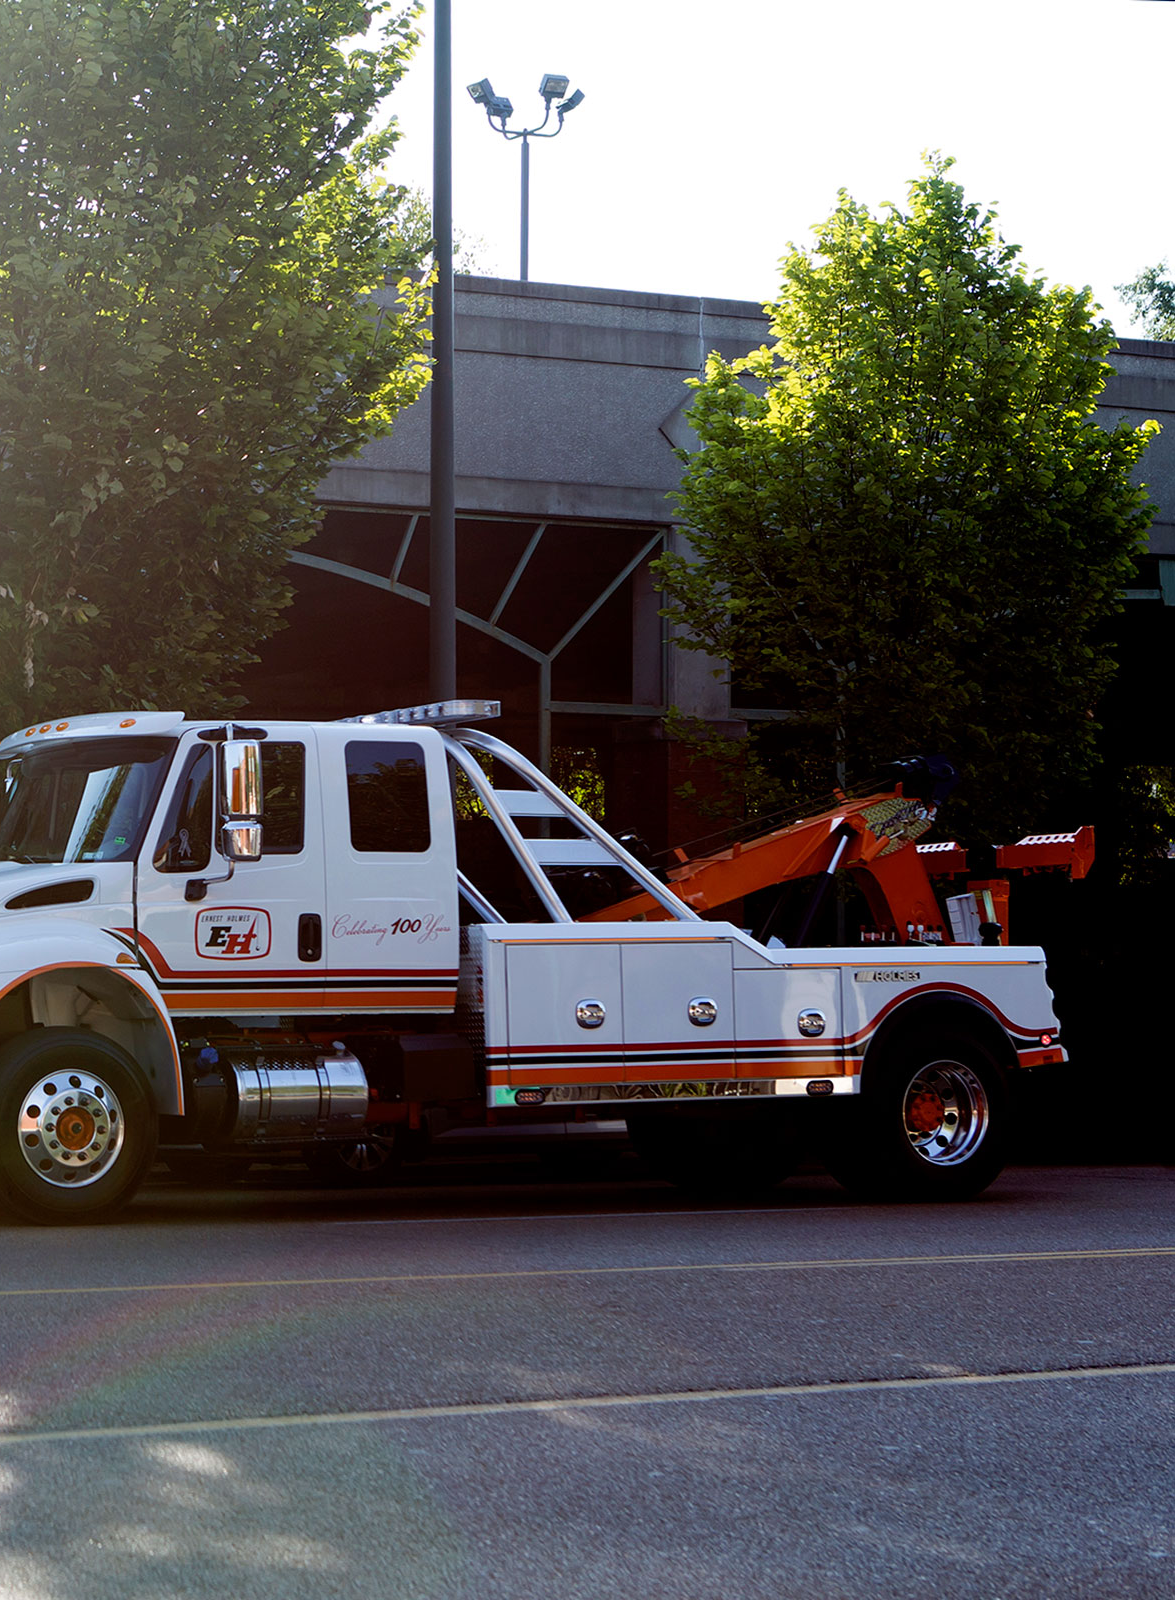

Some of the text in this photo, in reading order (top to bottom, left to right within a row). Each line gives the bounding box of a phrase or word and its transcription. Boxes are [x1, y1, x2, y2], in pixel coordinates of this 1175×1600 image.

[332, 914, 451, 945] Celebrating 100 Years
[874, 971, 920, 982] HOLMES
